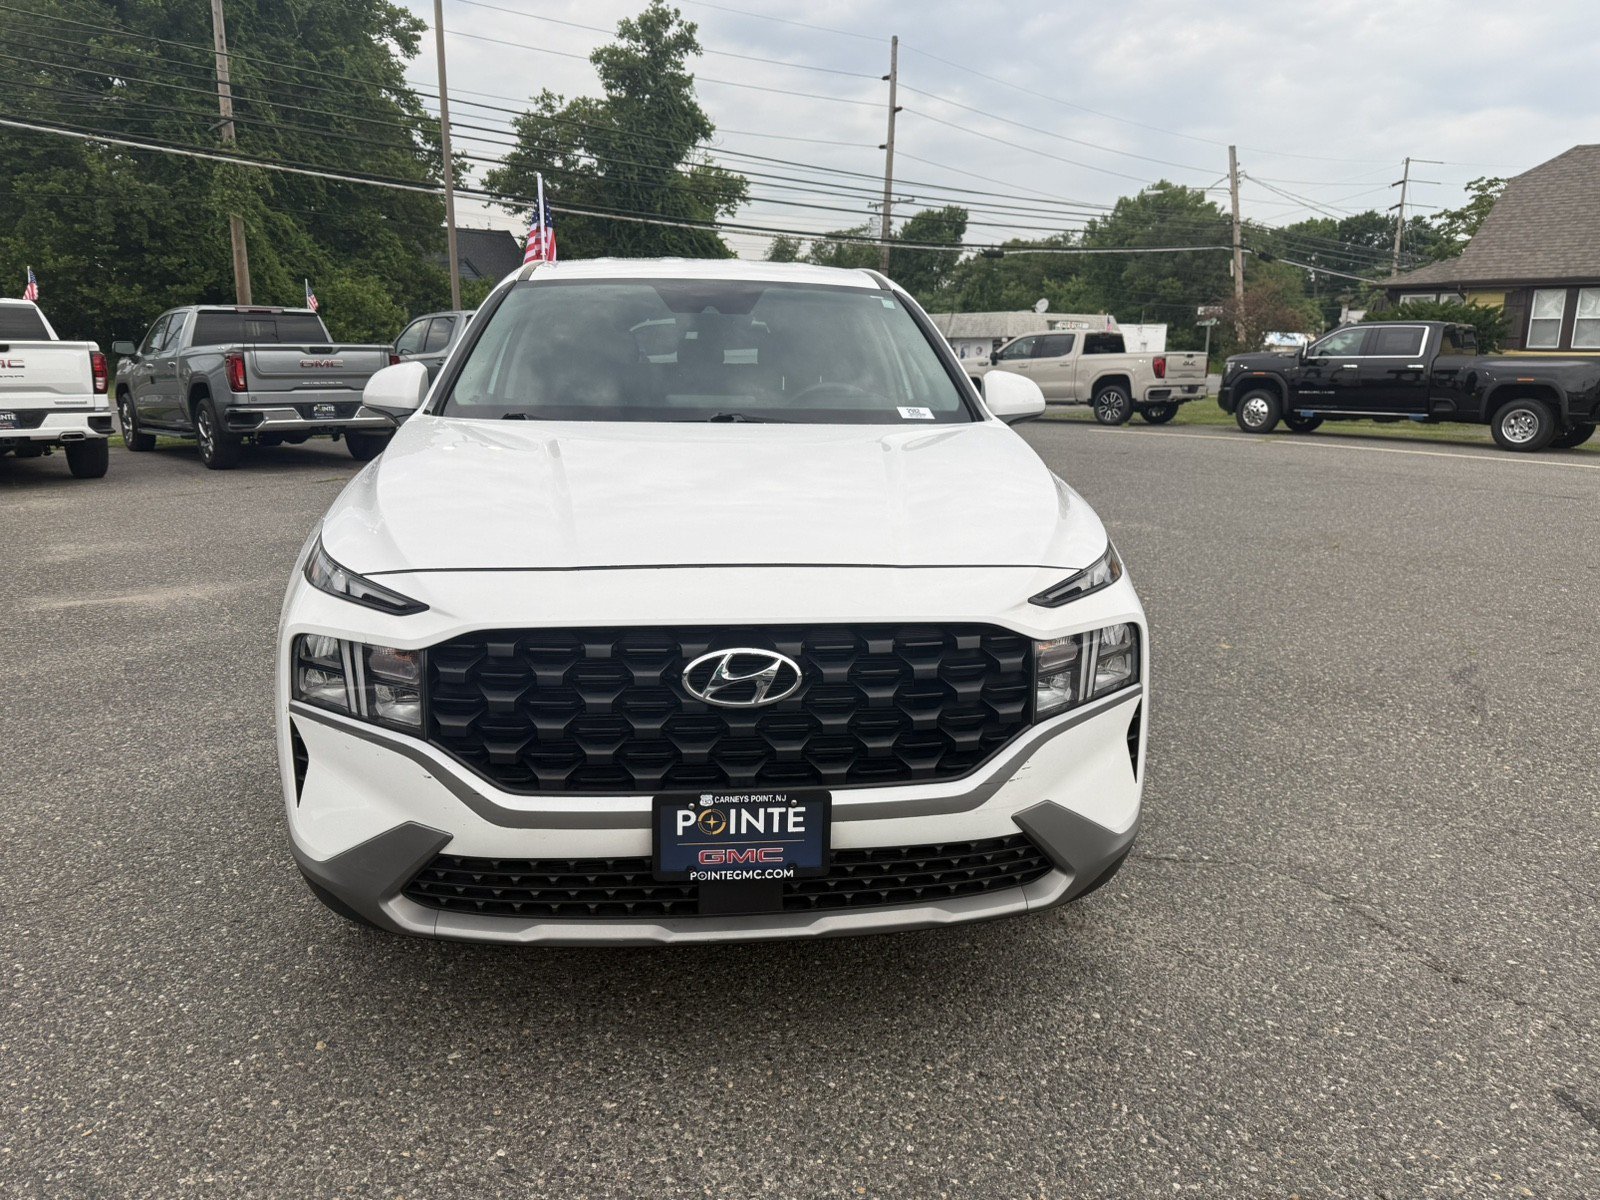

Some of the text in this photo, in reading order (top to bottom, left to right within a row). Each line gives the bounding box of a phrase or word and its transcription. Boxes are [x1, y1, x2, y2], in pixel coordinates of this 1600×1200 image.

[300, 360, 344, 368] GMC
[714, 795, 750, 804] CARNEYS
[776, 794, 787, 802] NJ
[676, 806, 806, 836] POINTE
[698, 847, 784, 865] GMC
[690, 868, 794, 881] POINTEGMC.COM
